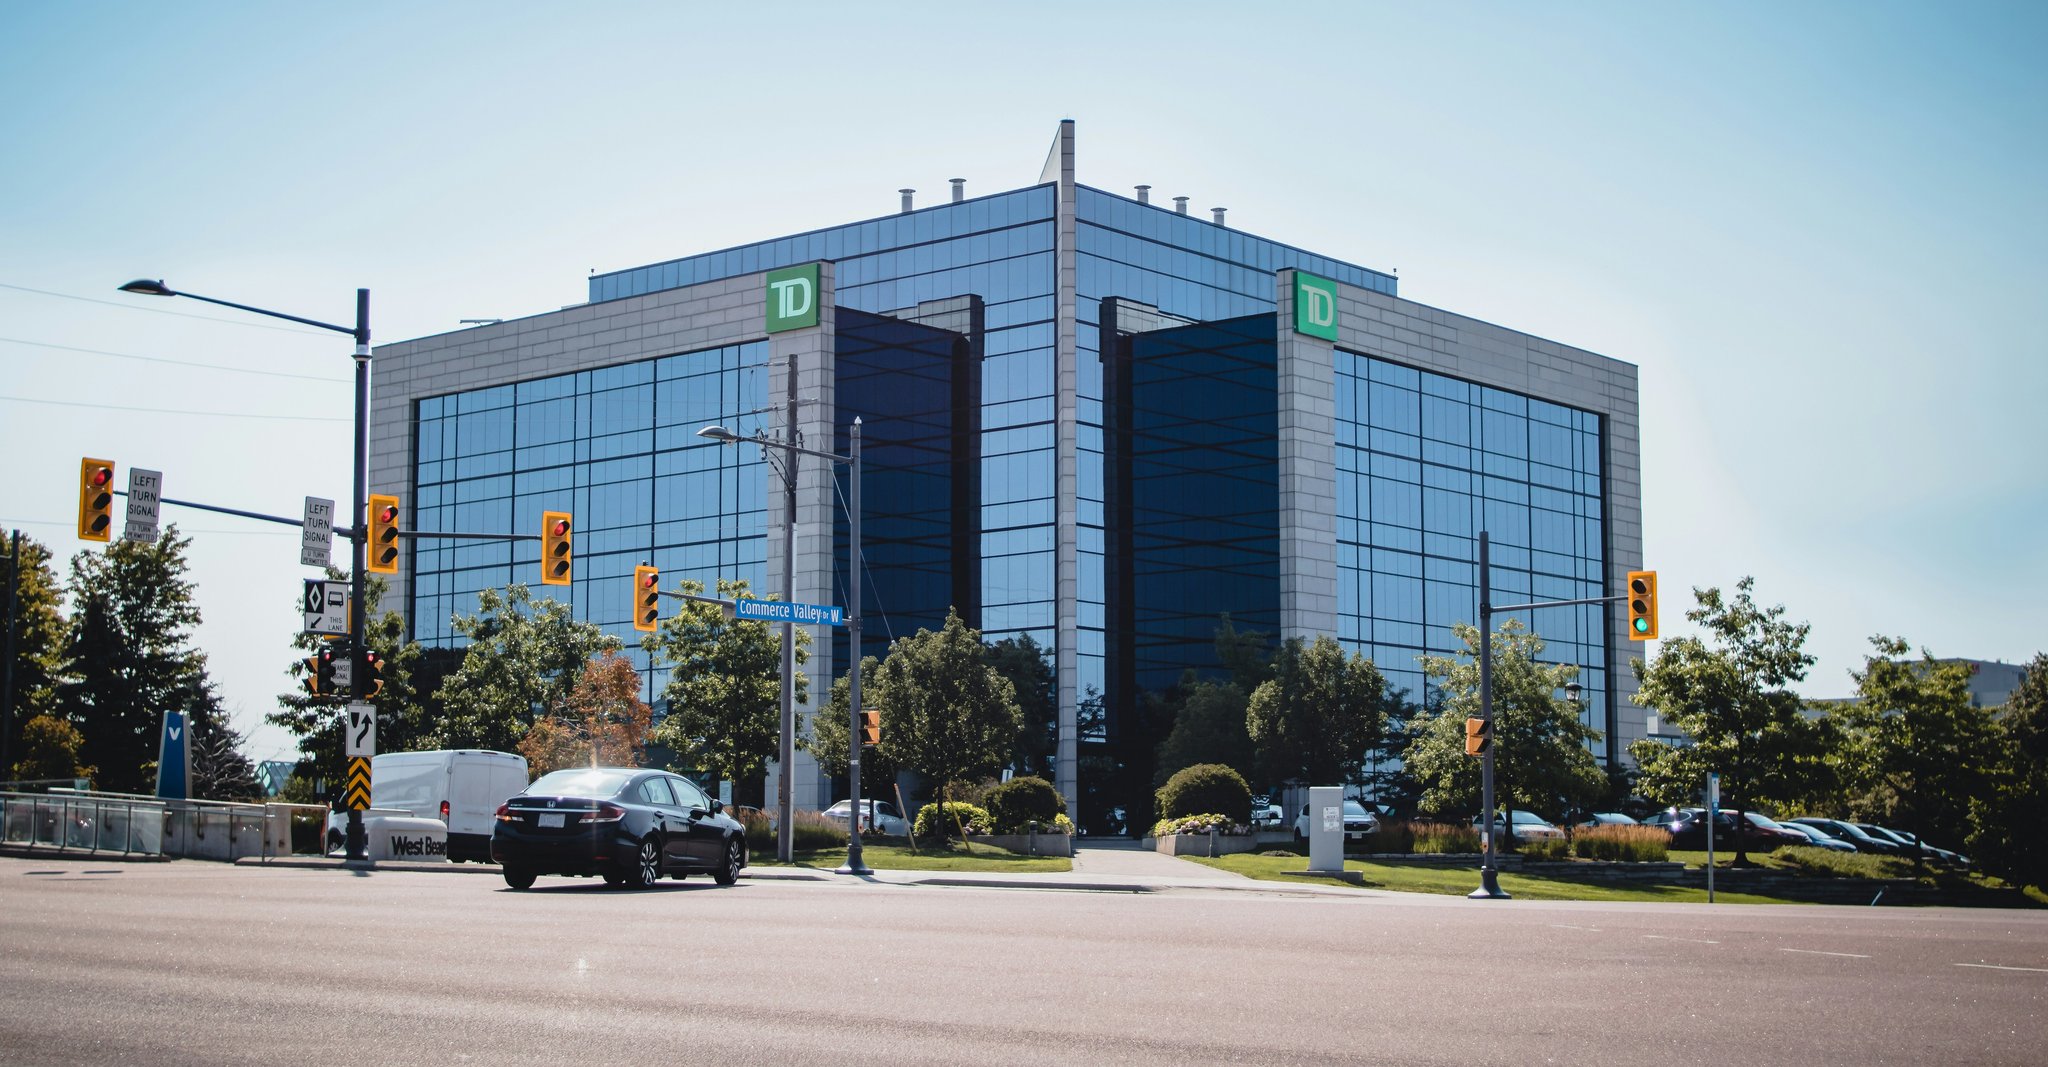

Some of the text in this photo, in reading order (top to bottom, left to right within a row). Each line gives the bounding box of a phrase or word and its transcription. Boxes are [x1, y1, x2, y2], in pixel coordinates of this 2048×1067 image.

[771, 277, 812, 319] TD
[1301, 284, 1334, 327] TD
[134, 475, 157, 488] LEFT
[133, 489, 157, 503] TURN
[129, 504, 157, 518] SIGNAL
[309, 503, 330, 516] LEFT
[308, 517, 330, 530] TURN
[304, 530, 330, 544] SIGNAL
[740, 600, 790, 618] Commerce
[793, 604, 821, 624] Valley
[830, 609, 840, 623] W
[329, 616, 343, 624] THIS
[391, 835, 424, 856] West
